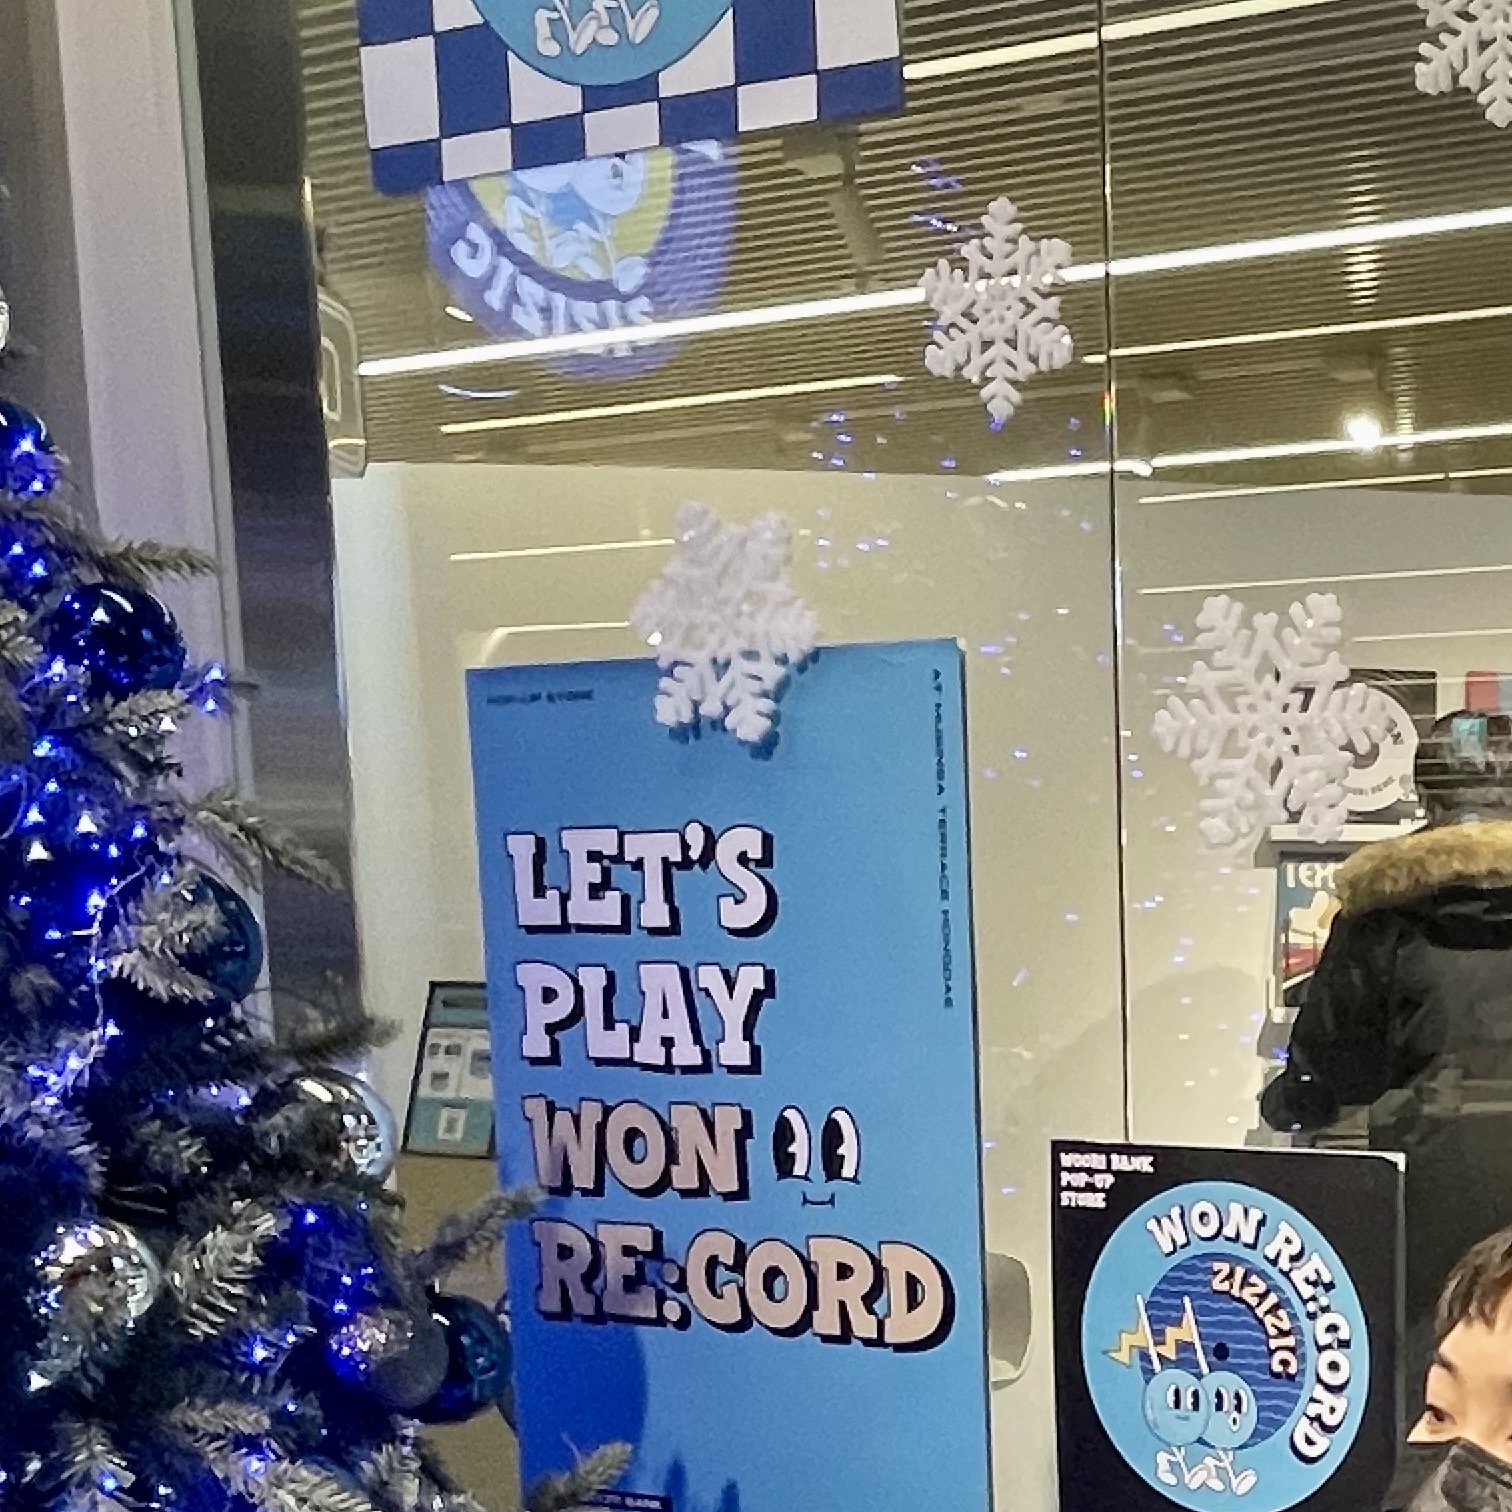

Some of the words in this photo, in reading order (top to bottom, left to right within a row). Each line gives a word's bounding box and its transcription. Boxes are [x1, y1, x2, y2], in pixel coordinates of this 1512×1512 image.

[932, 667, 943, 696] AT
[505, 819, 778, 937] LET'S
[937, 805, 949, 902] TERRACE
[516, 961, 776, 1076] PLAY
[522, 1094, 753, 1201] WON
[1060, 1191, 1107, 1209] STORE
[531, 1220, 956, 1353] RE:CORD
[1145, 1199, 1267, 1257] WON
[1262, 1219, 1352, 1465] RE:CORD
